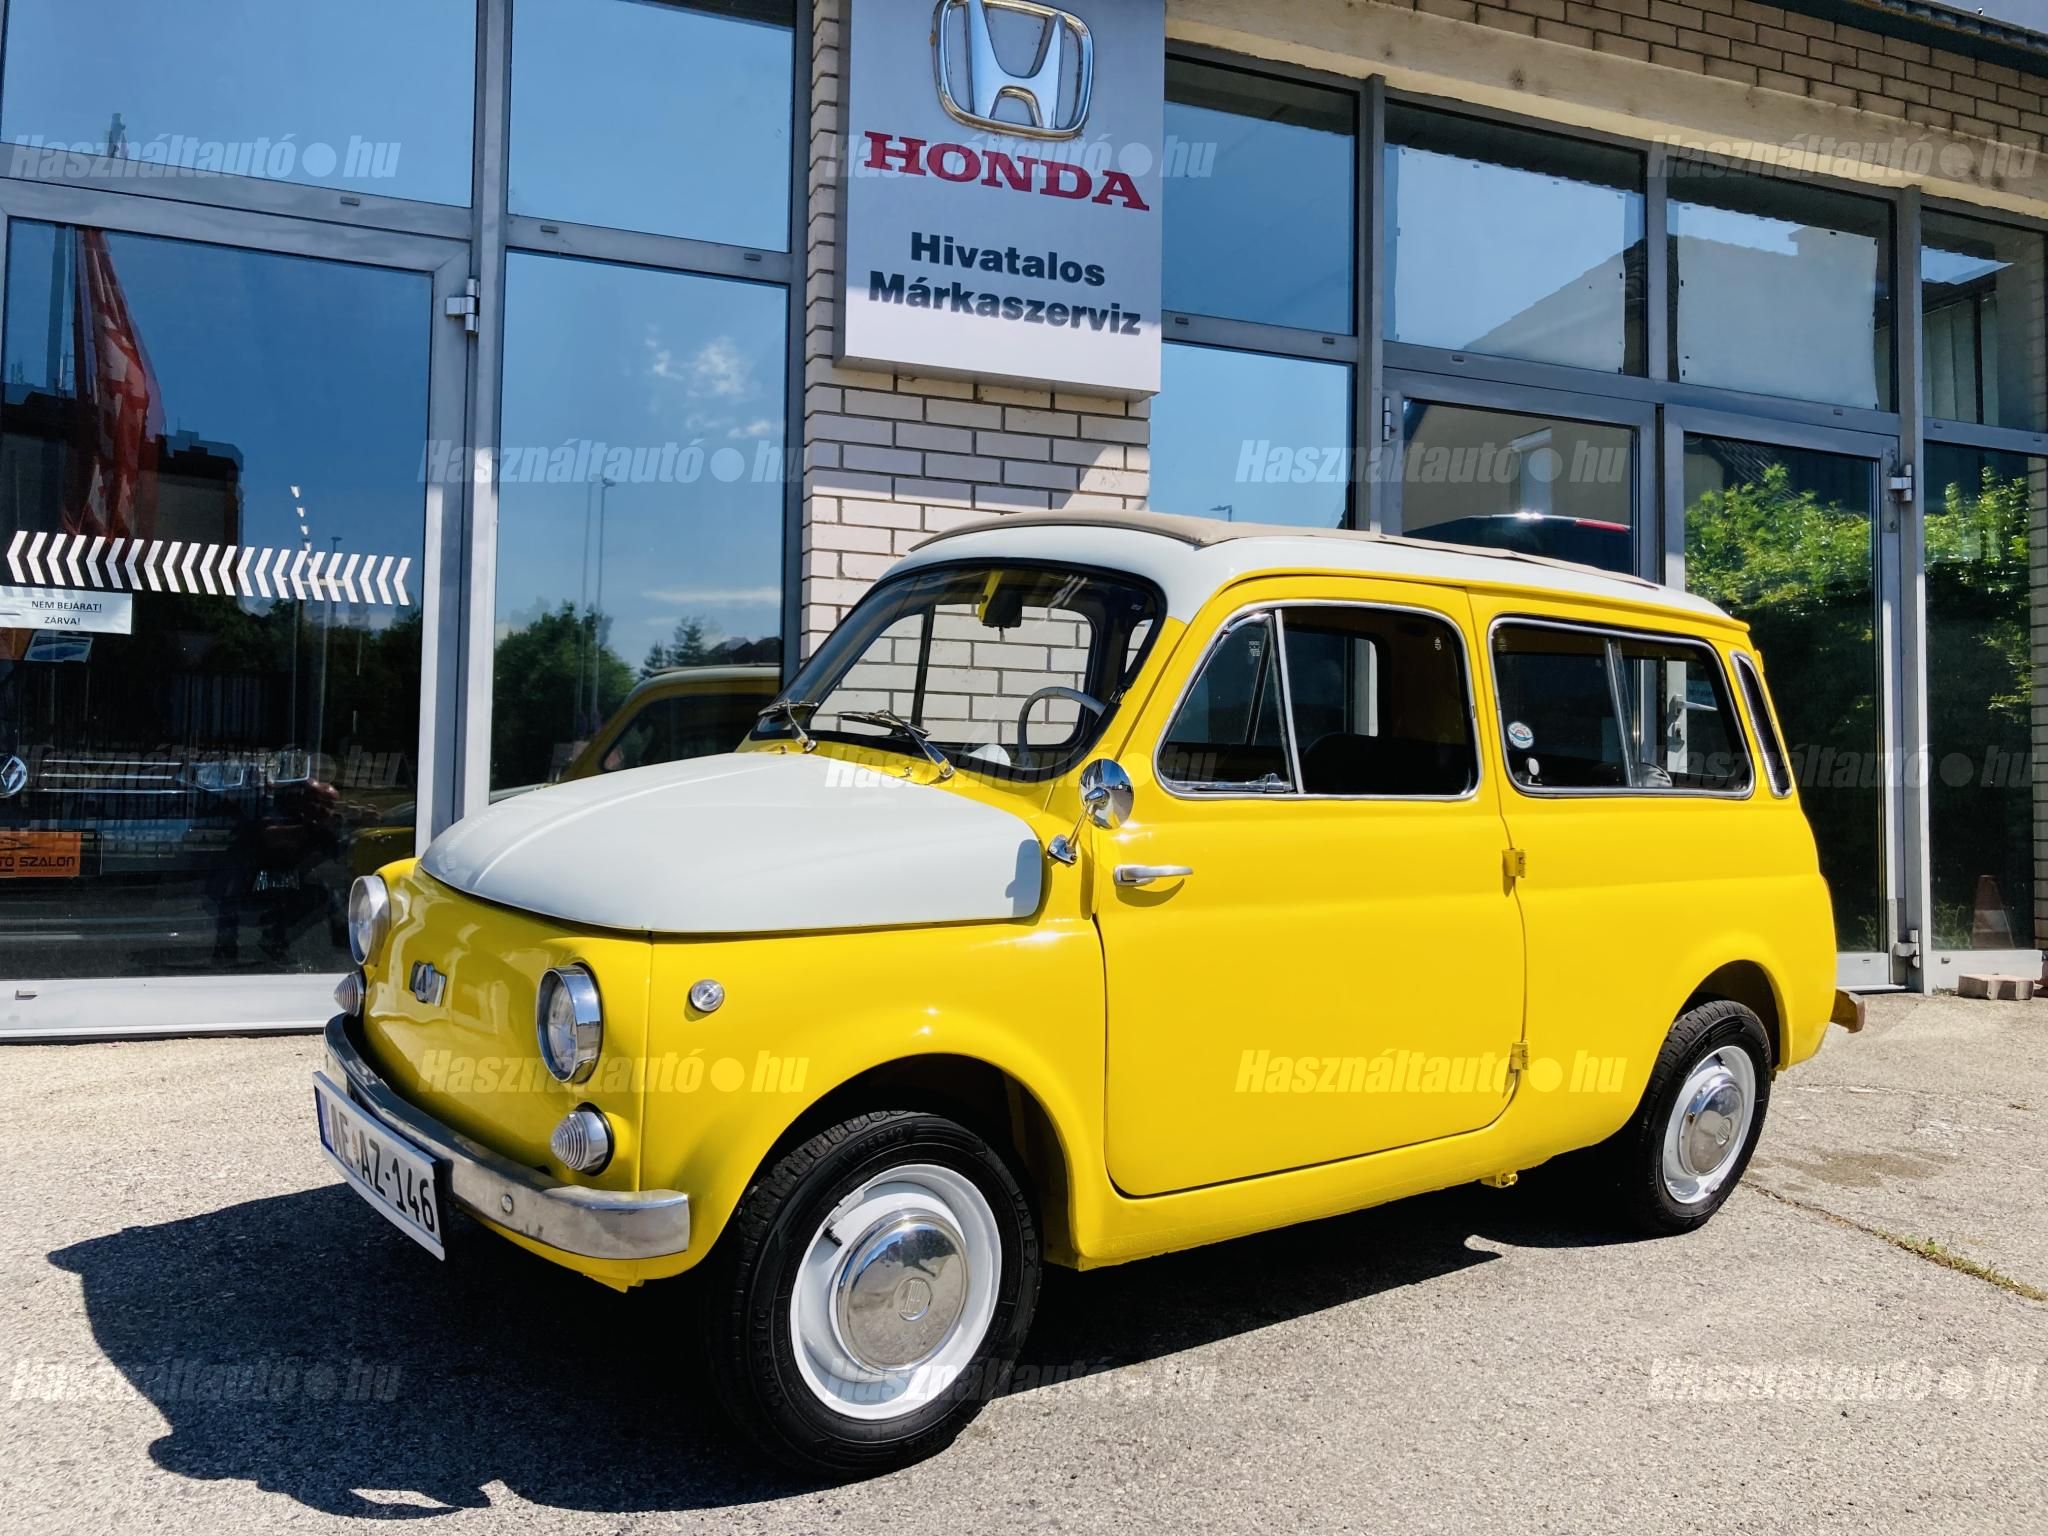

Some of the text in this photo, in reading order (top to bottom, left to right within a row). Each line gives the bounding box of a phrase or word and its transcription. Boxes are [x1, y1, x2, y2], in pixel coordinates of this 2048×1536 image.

[864, 131, 1150, 211] HONDA
[911, 231, 1106, 287] Hivatalos
[868, 270, 1141, 336] Márkaszerviz
[31, 600, 55, 609] NEM
[19, 856, 76, 868] SZALON
